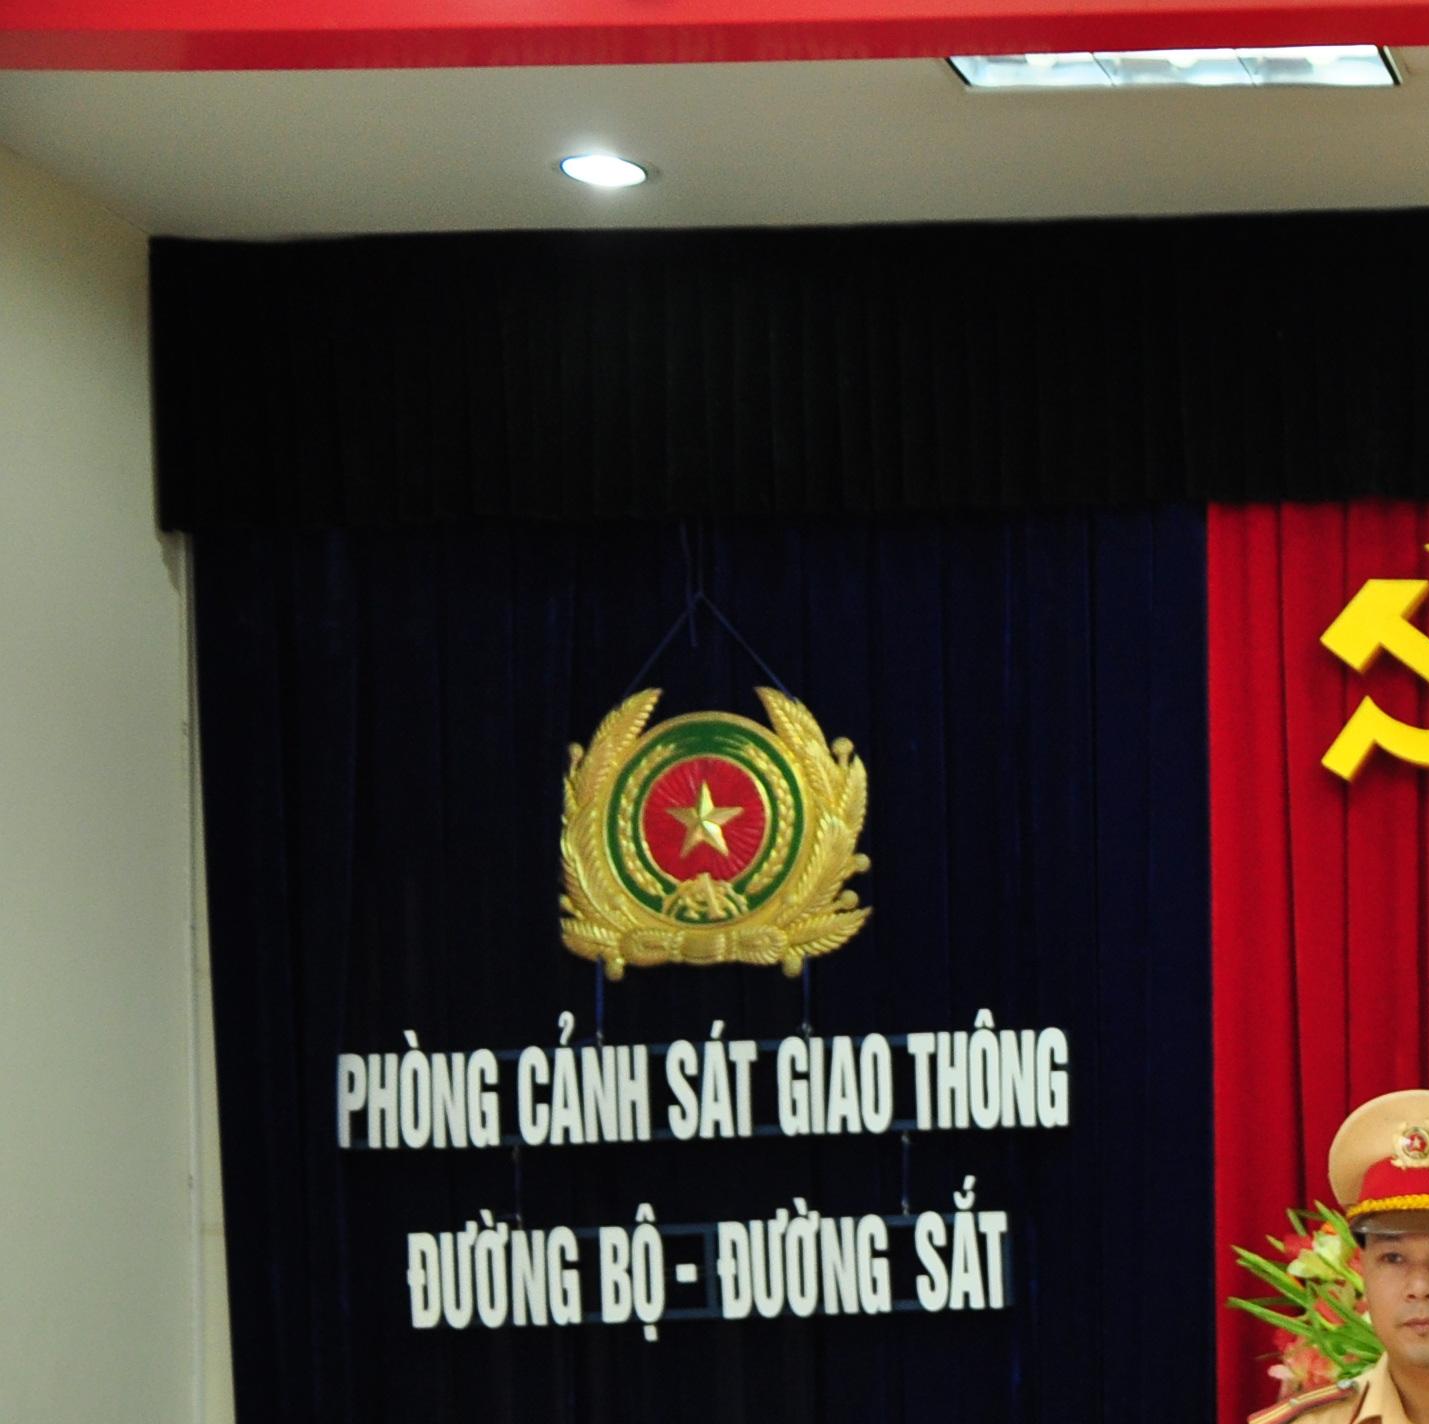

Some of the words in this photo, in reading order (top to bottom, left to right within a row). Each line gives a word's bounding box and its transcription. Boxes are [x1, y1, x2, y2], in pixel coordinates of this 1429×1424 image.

[338, 1029, 500, 1149] PHÒNG
[517, 1011, 651, 1146] CẢNH
[666, 1020, 757, 1140] SÁT
[776, 1033, 893, 1136] GIAO
[907, 1009, 1069, 1131] THÔNG
[407, 1209, 582, 1329] ĐƯỜNG
[599, 1203, 665, 1342] BỘ
[716, 1198, 892, 1319] ĐƯỜNG
[914, 1176, 1008, 1312] SẮT
